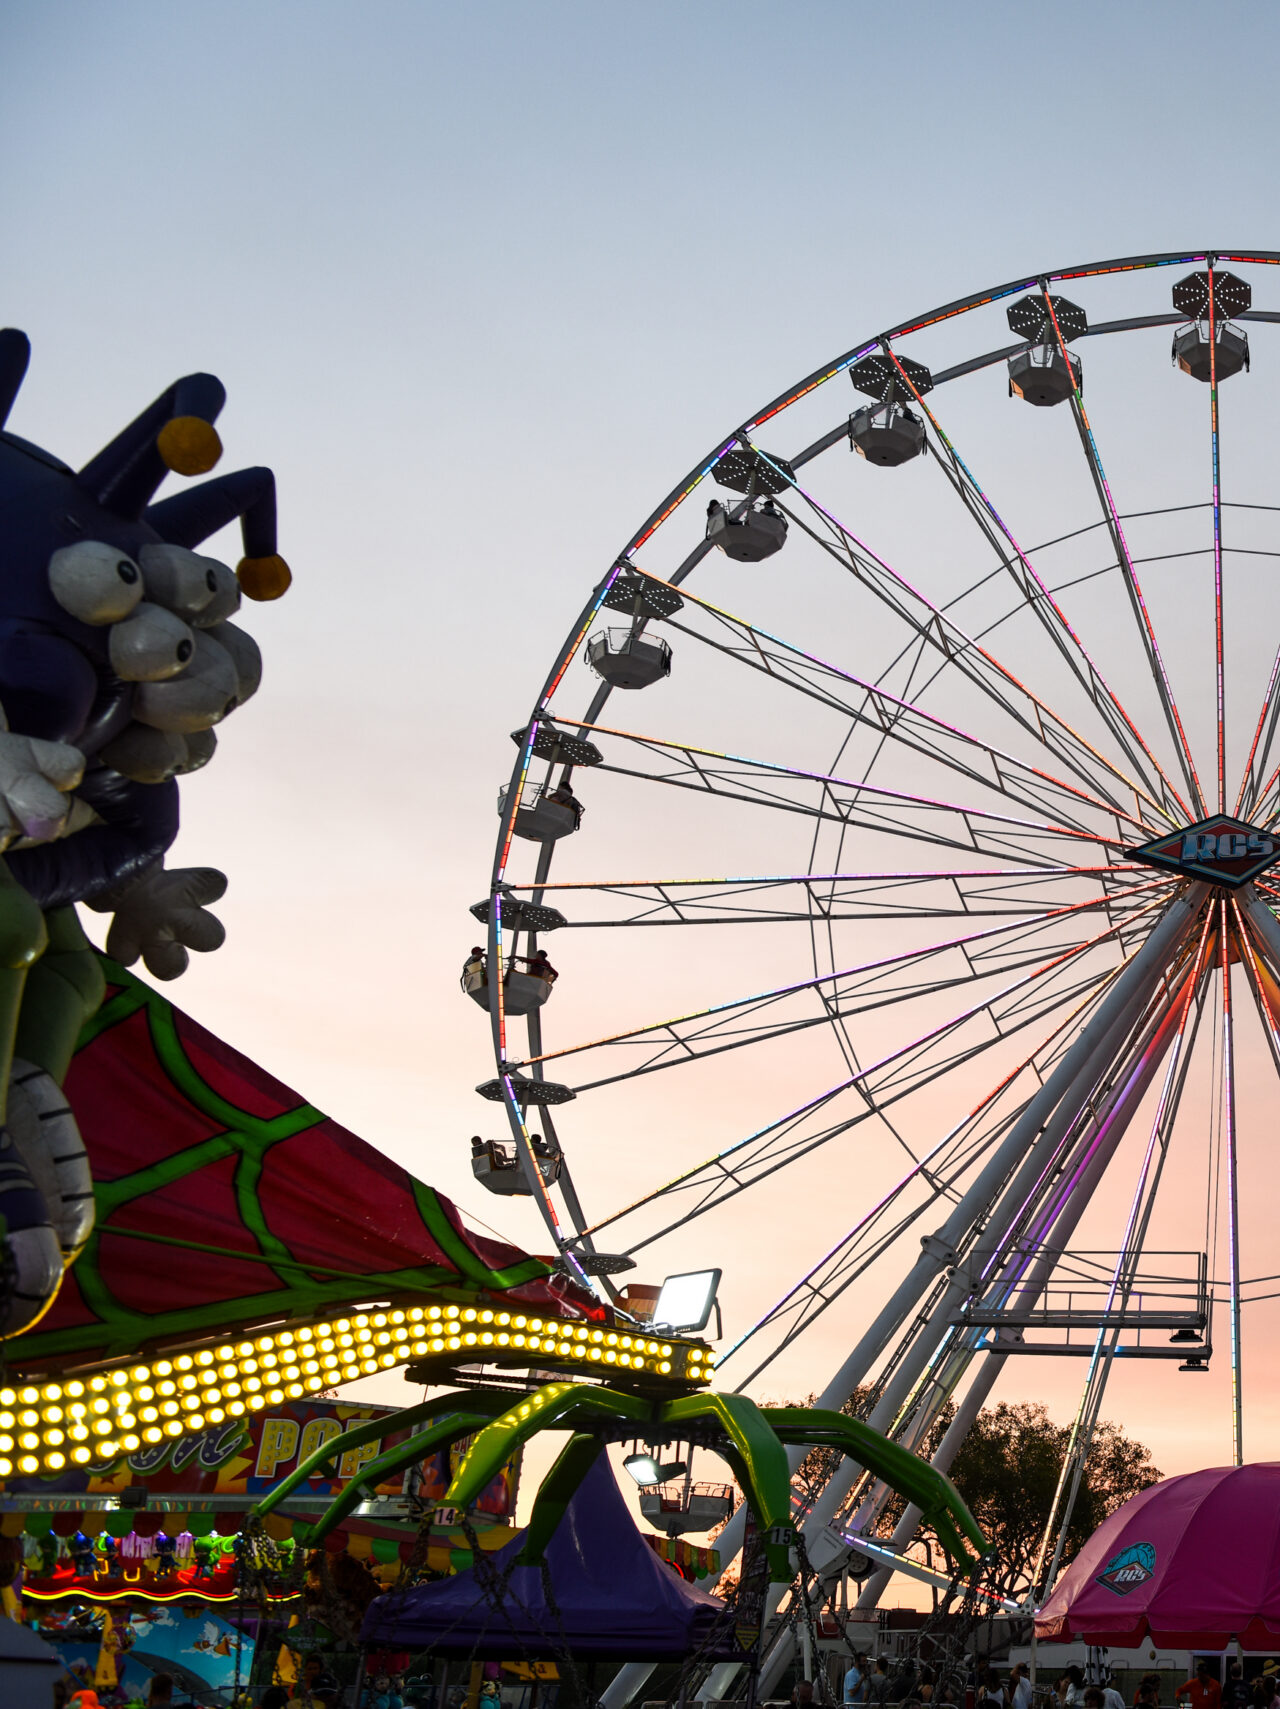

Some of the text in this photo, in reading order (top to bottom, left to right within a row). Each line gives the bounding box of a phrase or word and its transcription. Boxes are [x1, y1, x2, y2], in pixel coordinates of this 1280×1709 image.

[1182, 833, 1274, 861] RCS
[438, 1508, 454, 1525] 14
[775, 1527, 792, 1545] 15
